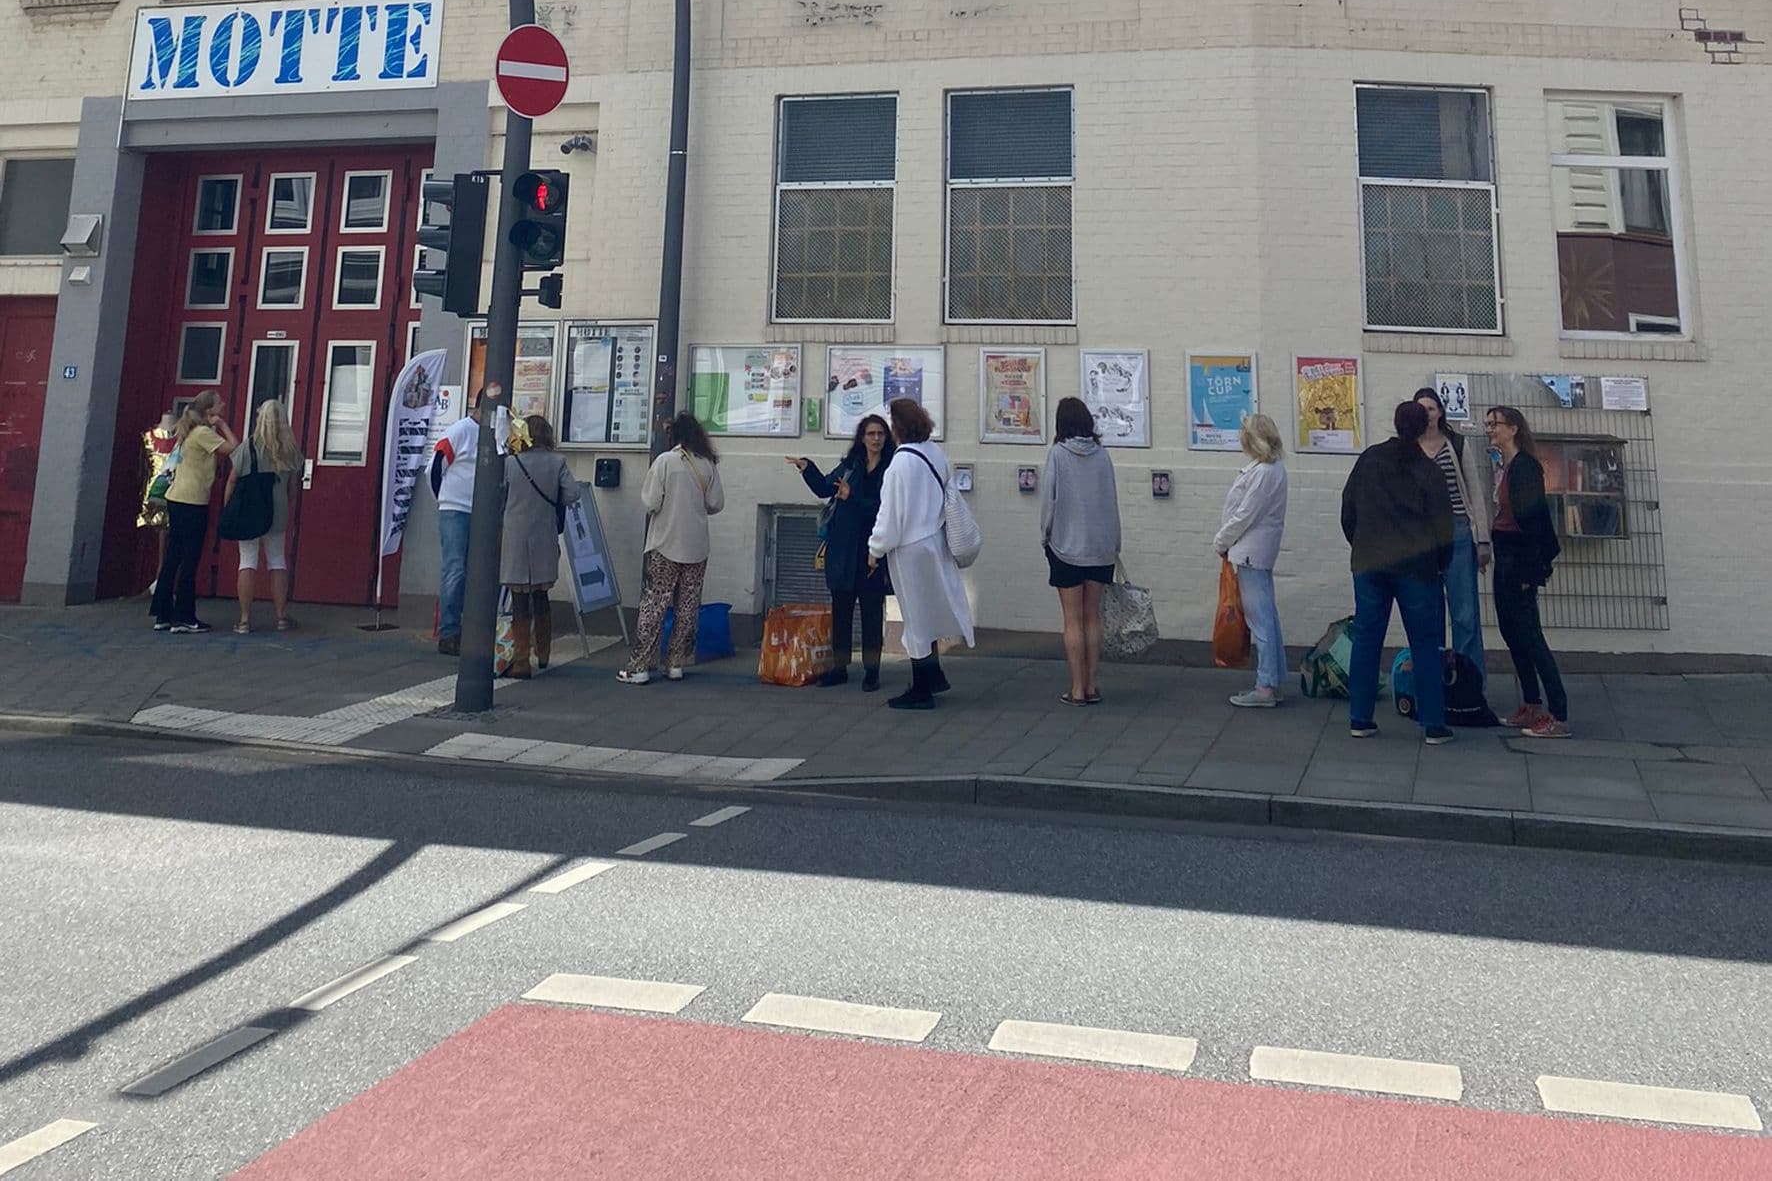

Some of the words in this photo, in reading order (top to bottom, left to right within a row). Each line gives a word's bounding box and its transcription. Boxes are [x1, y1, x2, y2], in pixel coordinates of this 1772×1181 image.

[140, 3, 432, 90] MOTTE
[64, 367, 75, 378] 43
[1208, 386, 1232, 395] CUP
[390, 418, 430, 538] MOTTE
